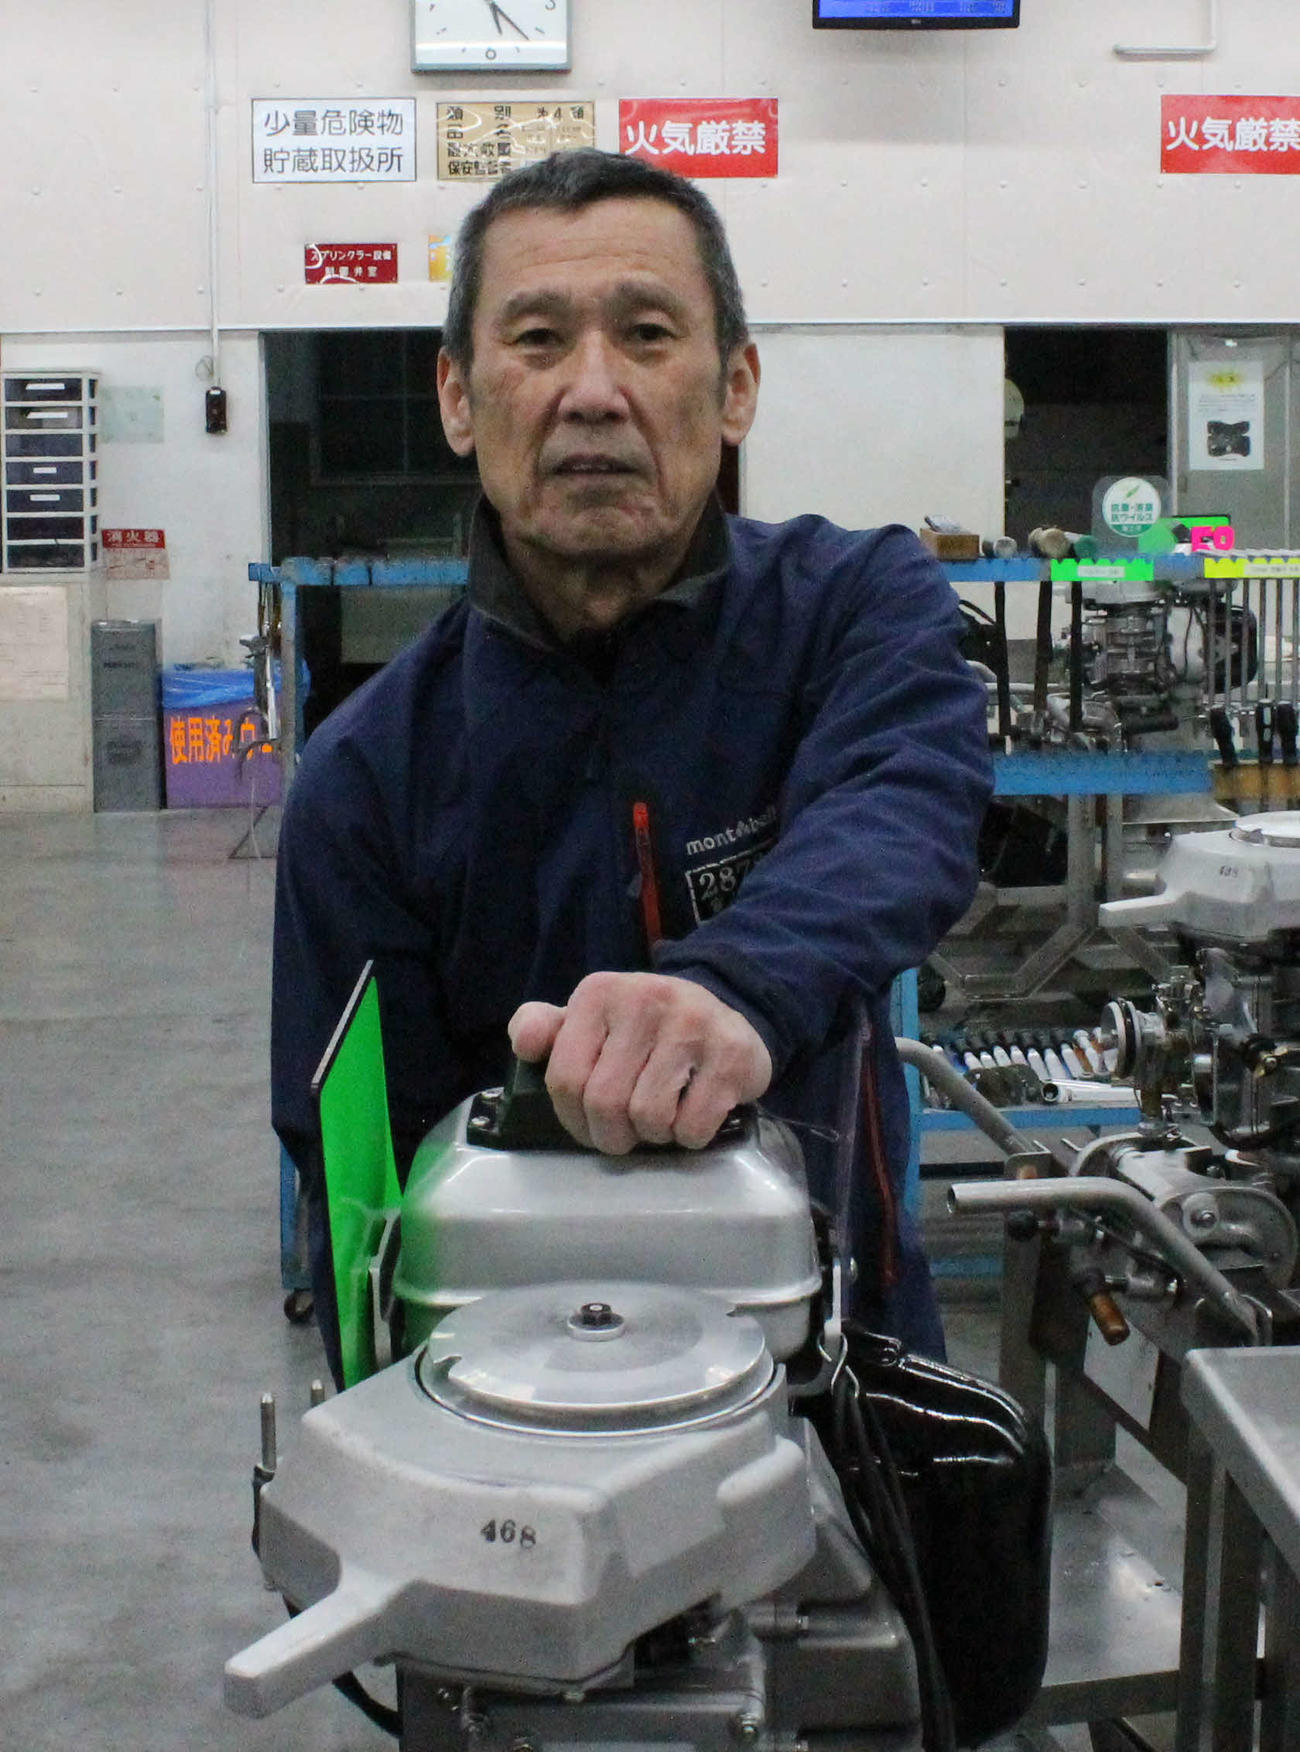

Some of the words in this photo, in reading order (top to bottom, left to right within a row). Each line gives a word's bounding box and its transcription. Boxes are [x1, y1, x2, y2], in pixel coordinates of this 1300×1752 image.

[264, 109, 403, 136] 少量危険物
[625, 120, 766, 155] 火気厳禁
[1165, 116, 1300, 151] 火気厳禁
[264, 147, 403, 173] 貯蔵取扱所
[480, 1518, 537, 1549] 468
